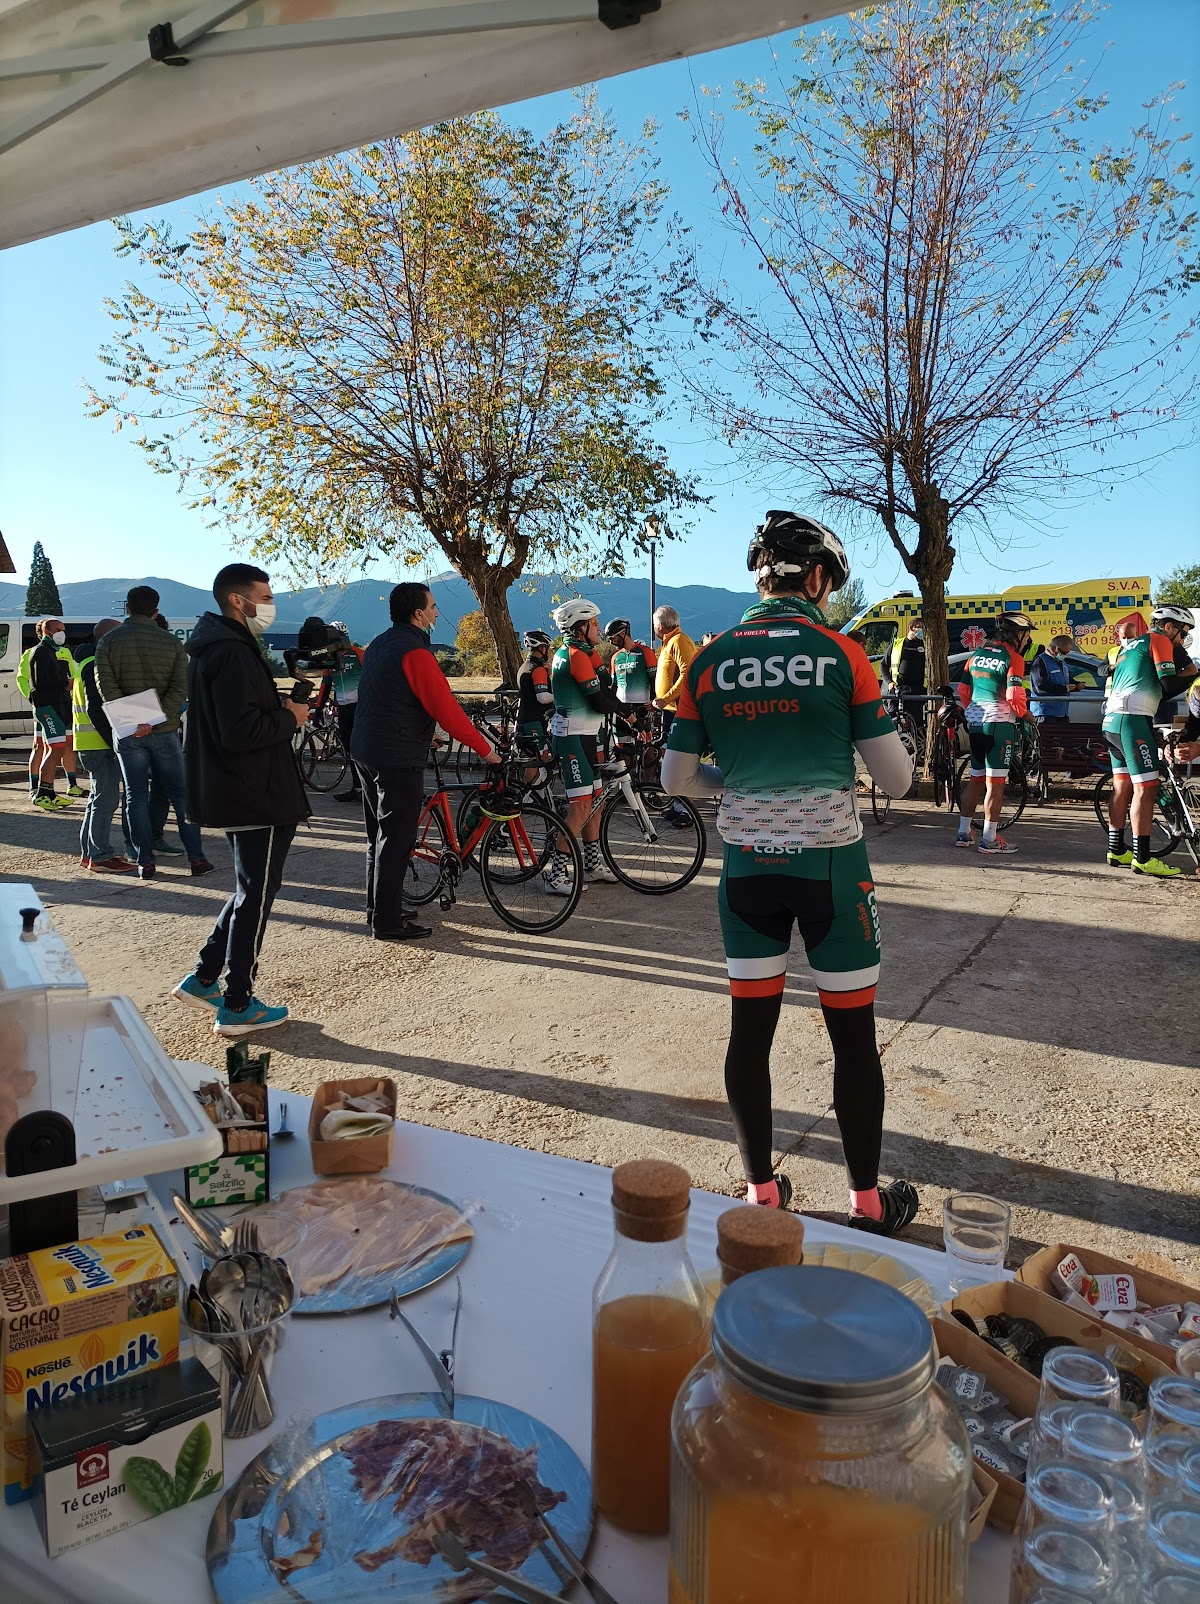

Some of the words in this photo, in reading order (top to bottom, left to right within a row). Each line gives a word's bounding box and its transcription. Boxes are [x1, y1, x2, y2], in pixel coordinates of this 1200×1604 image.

[1107, 581, 1144, 591] S.V.A.
[1050, 626, 1072, 635] 619
[1075, 625, 1098, 635] 288
[310, 648, 328, 656] RONIN
[617, 660, 639, 670] caser
[716, 654, 838, 691] caser
[972, 655, 1006, 673] caser
[723, 698, 800, 721] seguros
[45, 717, 57, 735] caser
[1004, 744, 1012, 767] caser
[1140, 743, 1154, 769] caser
[570, 758, 583, 784] caser
[857, 902, 872, 941] seguros
[209, 1178, 246, 1190] salzillo
[52, 1244, 115, 1289] Nesquik
[1060, 1259, 1078, 1279] Eva
[1, 1282, 28, 1313] CACAO
[1116, 1277, 1130, 1306] Eva
[9, 1306, 60, 1332] CACAO
[9, 1328, 37, 1340] NATURAL
[9, 1331, 59, 1353] SOSTENIBLE
[26, 1333, 160, 1412] Nesquik
[962, 1376, 974, 1395] ARIAS
[202, 1468, 214, 1481] 20
[61, 1497, 79, 1514] Té
[82, 1483, 126, 1507] Ceylan
[76, 1516, 99, 1529] BLACK
[99, 1511, 113, 1522] TEA
[81, 1507, 108, 1522] CEYLON
